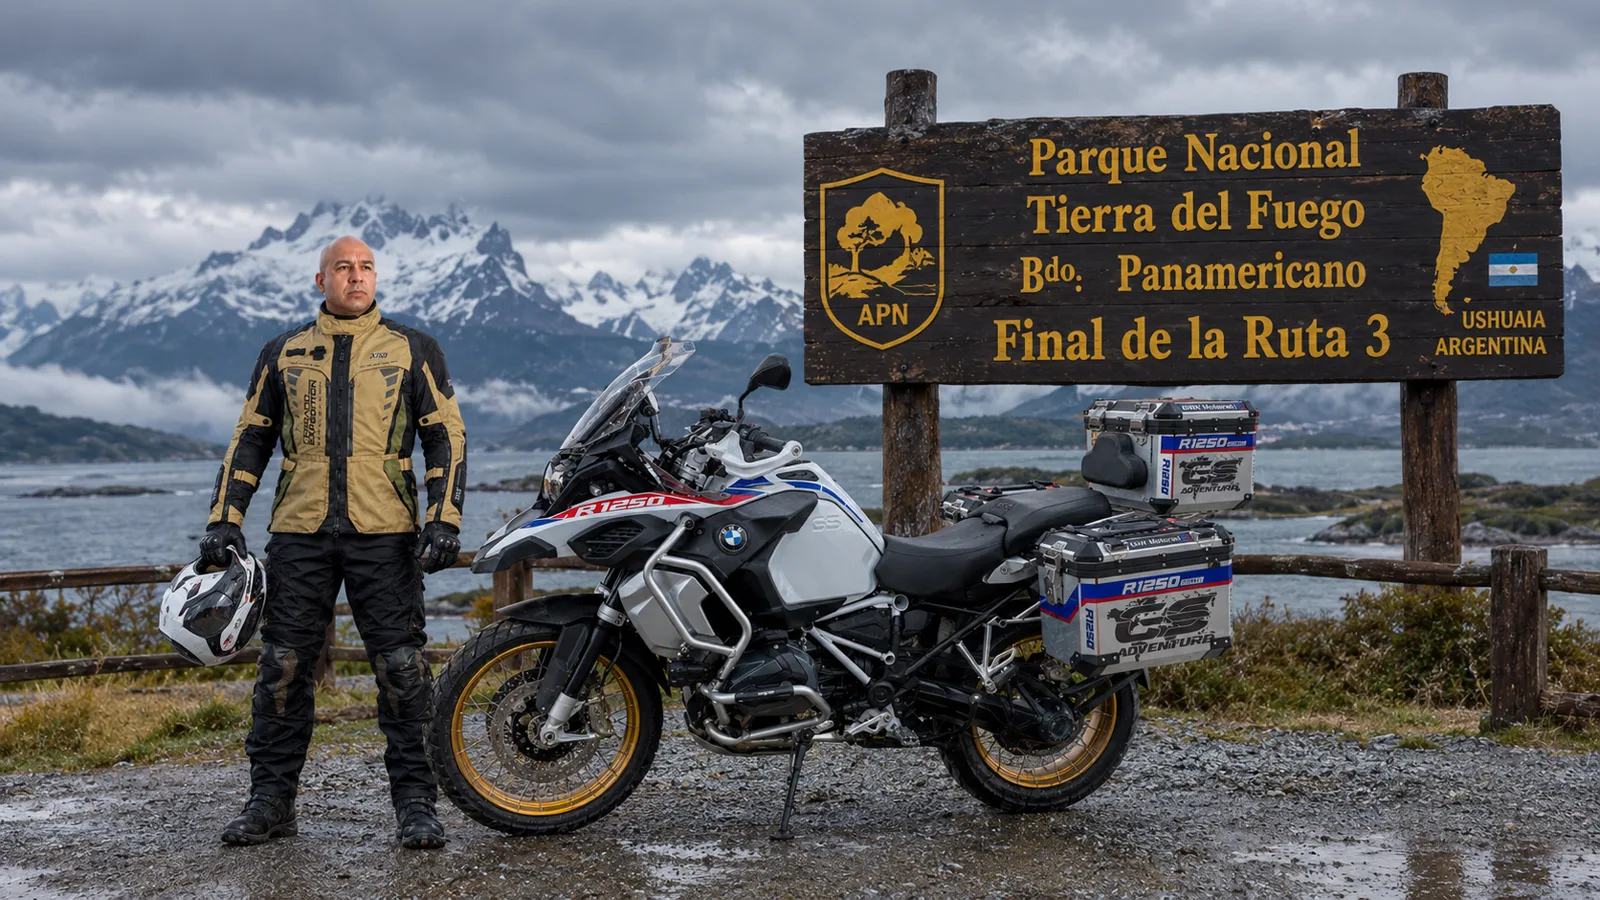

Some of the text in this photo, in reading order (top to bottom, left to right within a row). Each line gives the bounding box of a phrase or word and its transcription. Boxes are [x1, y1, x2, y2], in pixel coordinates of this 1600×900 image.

[1029, 128, 1361, 185] Parque Nacional
[1027, 190, 1365, 240] Tierra del Fuego
[1118, 254, 1366, 292] Panamericano
[858, 304, 908, 326] APN
[1462, 310, 1546, 329] USHUAIA
[994, 313, 1391, 361] Final de la Ruta 3
[1436, 336, 1547, 356] ARGENTINA
[1179, 437, 1228, 450] R1250
[575, 496, 665, 519] R1250
[1121, 575, 1181, 596] R1250
